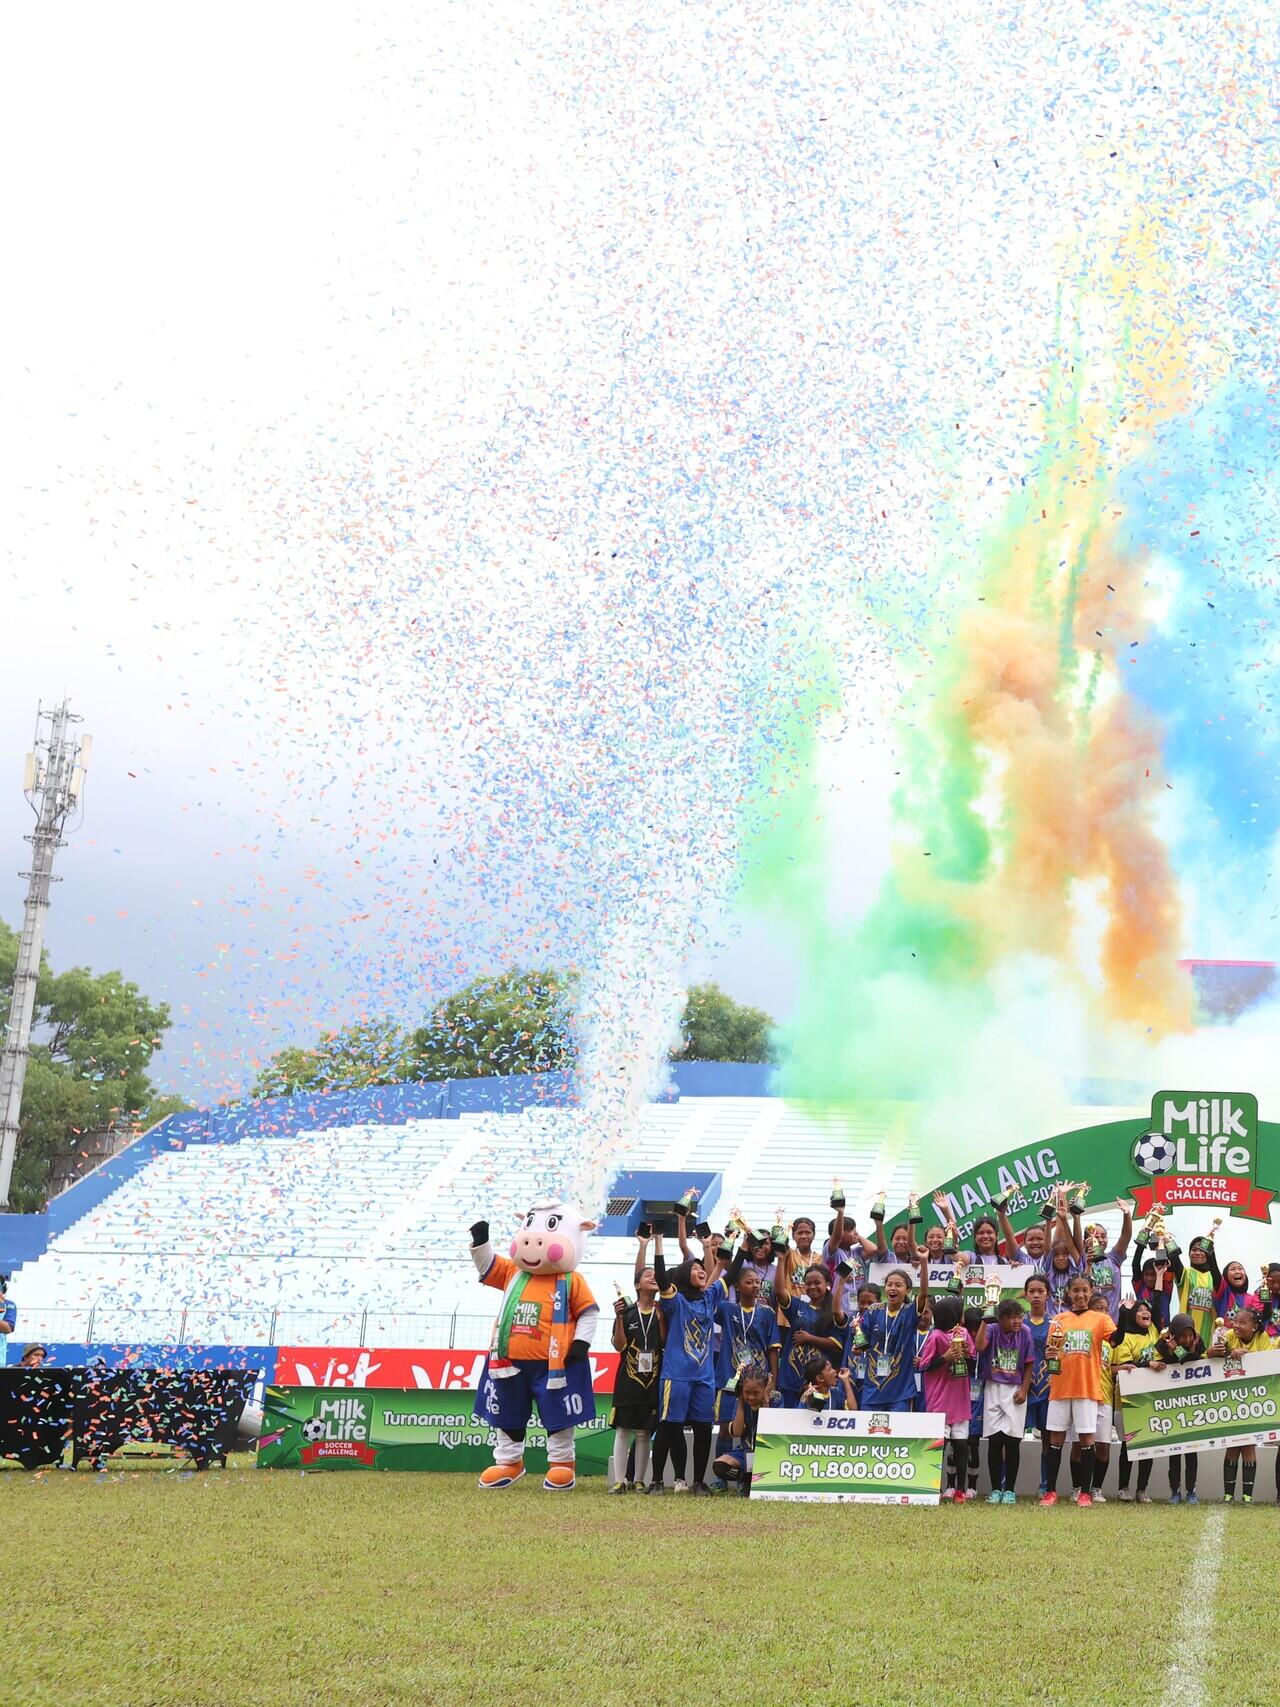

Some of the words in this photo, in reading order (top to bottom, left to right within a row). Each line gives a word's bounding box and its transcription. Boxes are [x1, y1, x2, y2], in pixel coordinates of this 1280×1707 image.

[1163, 1099, 1248, 1137] Milk
[1176, 1136, 1250, 1174] Life
[1176, 1178, 1227, 1189] SOCCER
[1165, 1189, 1238, 1202] CHALLENGE
[514, 1302, 538, 1315] Milk
[966, 1295, 983, 1308] KU
[516, 1313, 537, 1326] Life
[1067, 1329, 1089, 1341] Milk
[1070, 1340, 1090, 1351] Life
[1184, 1365, 1212, 1380] BCA
[562, 1393, 583, 1416] 10
[1154, 1393, 1207, 1412] RUNNER
[1210, 1390, 1228, 1403] UP
[1231, 1387, 1249, 1402] KU
[1251, 1385, 1267, 1398] 10
[320, 1398, 367, 1420] Milk
[1149, 1416, 1173, 1435] Rp
[1176, 1400, 1277, 1428] 1.200.000
[383, 1410, 465, 1427] Turnamen
[577, 1414, 607, 1429] utri
[827, 1417, 856, 1430] BCA
[326, 1420, 367, 1441] Life
[438, 1431, 463, 1450] KU
[466, 1435, 481, 1447] 10
[486, 1432, 498, 1447] &
[530, 1435, 547, 1447] 12
[789, 1443, 845, 1457] RUNNER
[849, 1445, 866, 1458] UP
[871, 1446, 890, 1460] KU
[893, 1446, 909, 1458] 12
[779, 1461, 804, 1481] Rp
[809, 1461, 916, 1480] 1.800.000
